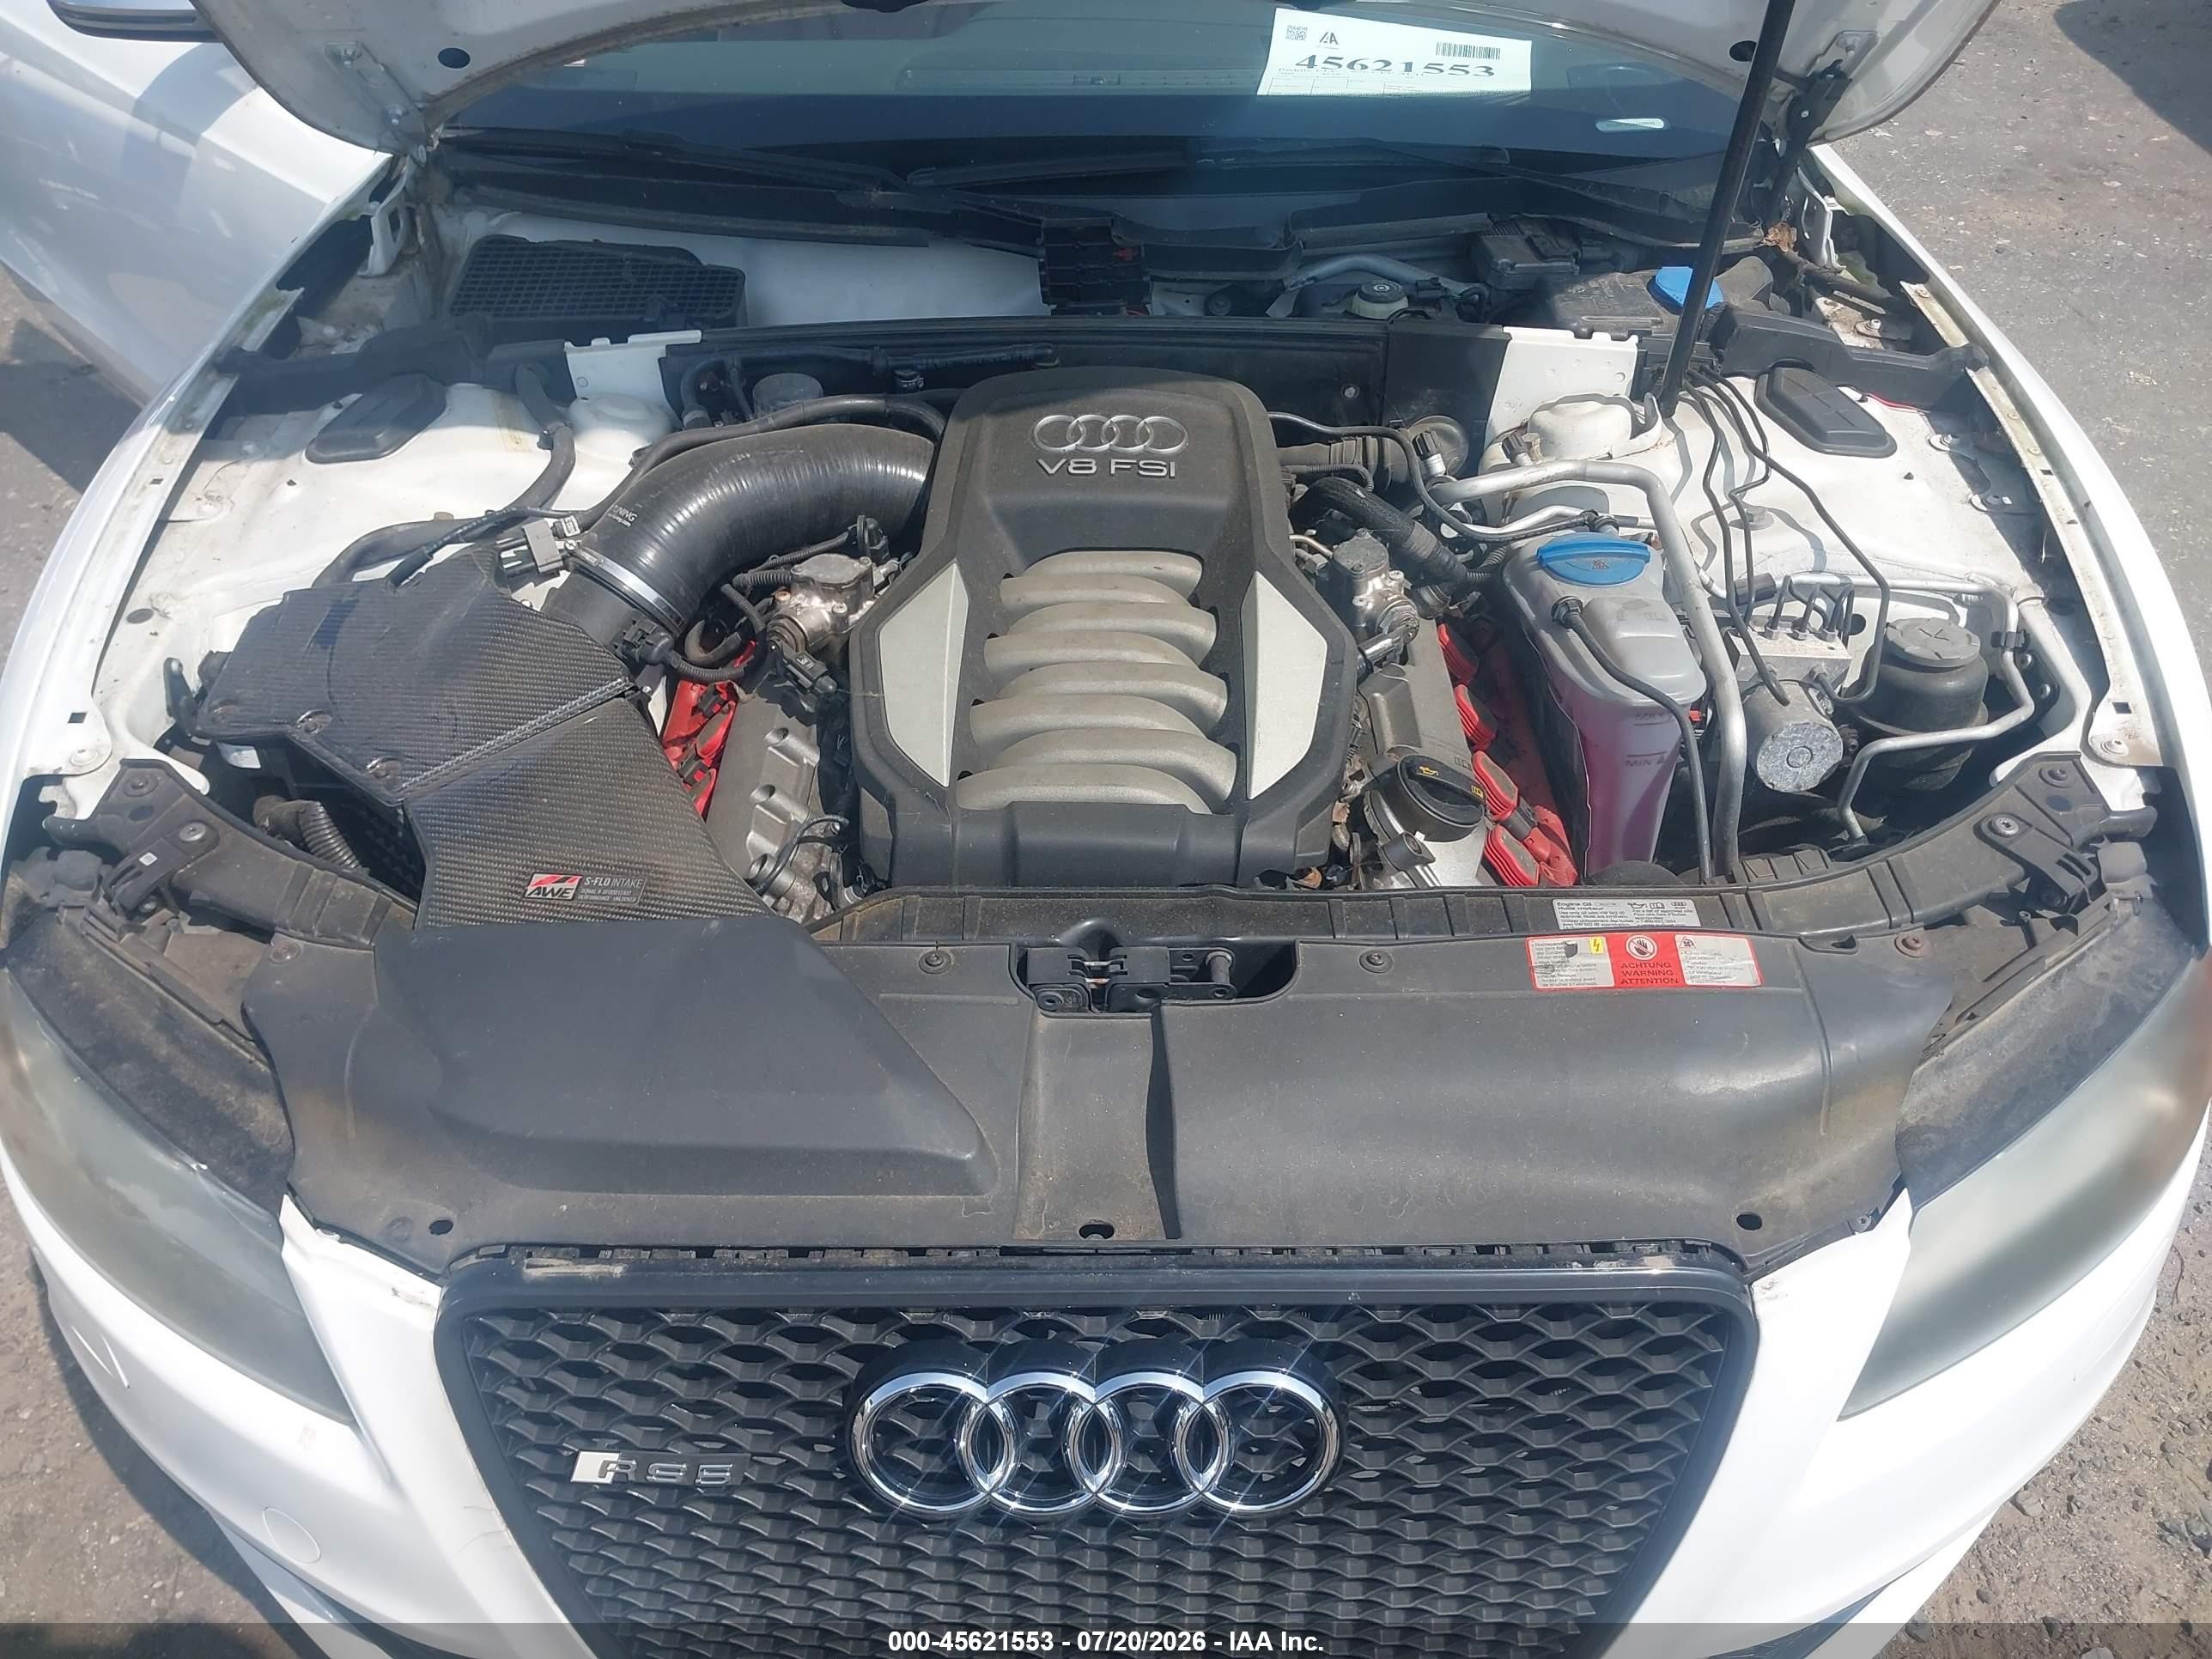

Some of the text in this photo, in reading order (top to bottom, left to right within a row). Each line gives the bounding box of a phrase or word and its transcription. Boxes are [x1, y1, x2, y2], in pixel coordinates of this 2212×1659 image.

[1296, 55, 1495, 77] 45621553
[1036, 458, 1176, 478] V8 FSI
[527, 886, 574, 898] AWE
[611, 878, 643, 888] INTAKE
[597, 1459, 734, 1485] RS5
